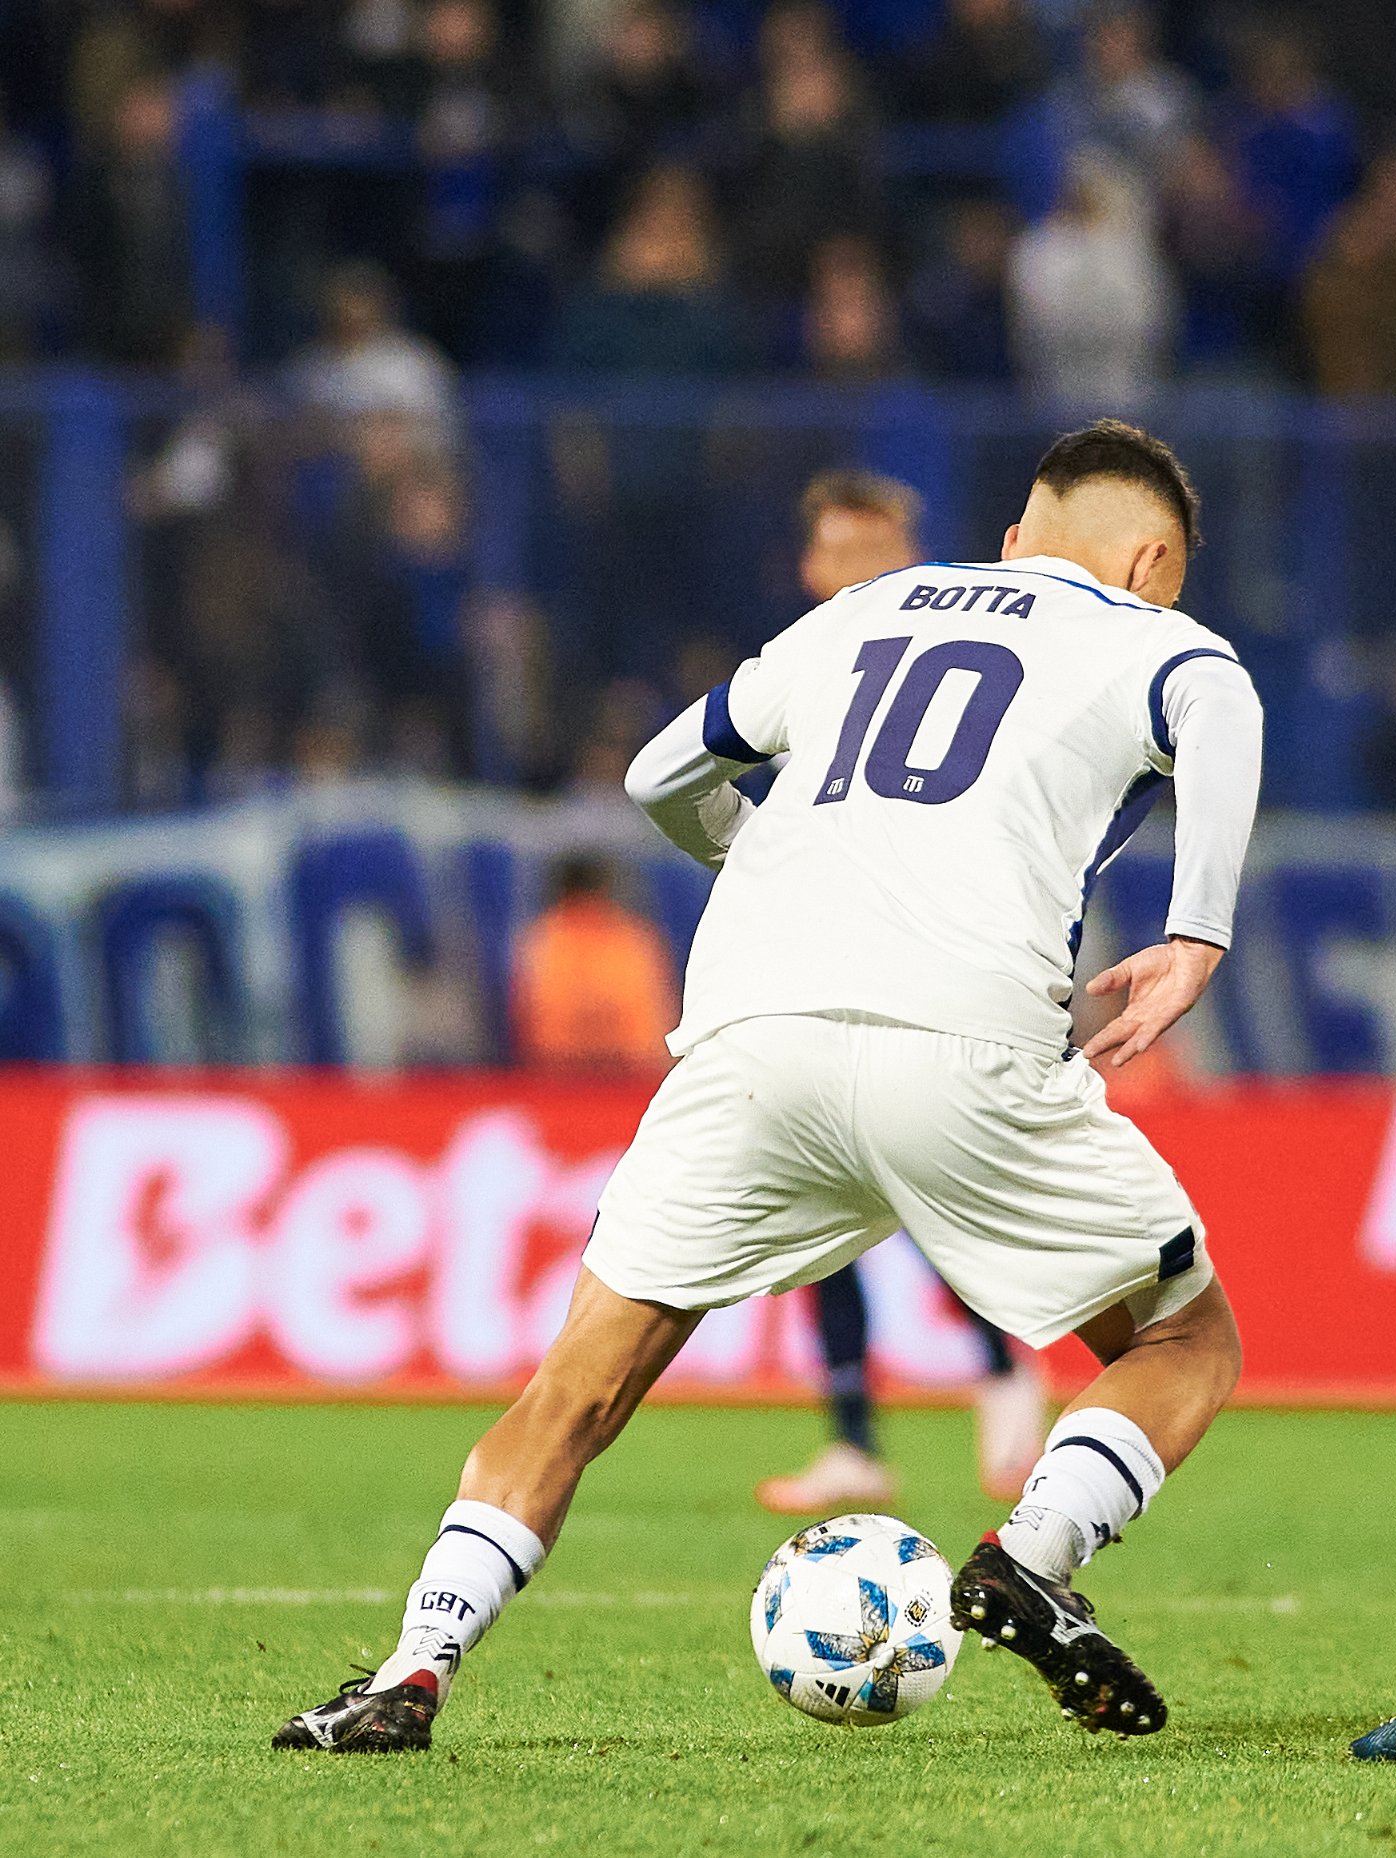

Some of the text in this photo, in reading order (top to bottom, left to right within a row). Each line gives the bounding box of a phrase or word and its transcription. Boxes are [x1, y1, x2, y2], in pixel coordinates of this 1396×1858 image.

[899, 584, 1037, 619] BOTTA
[812, 635, 1025, 806] 10
[419, 1591, 476, 1622] GBT
